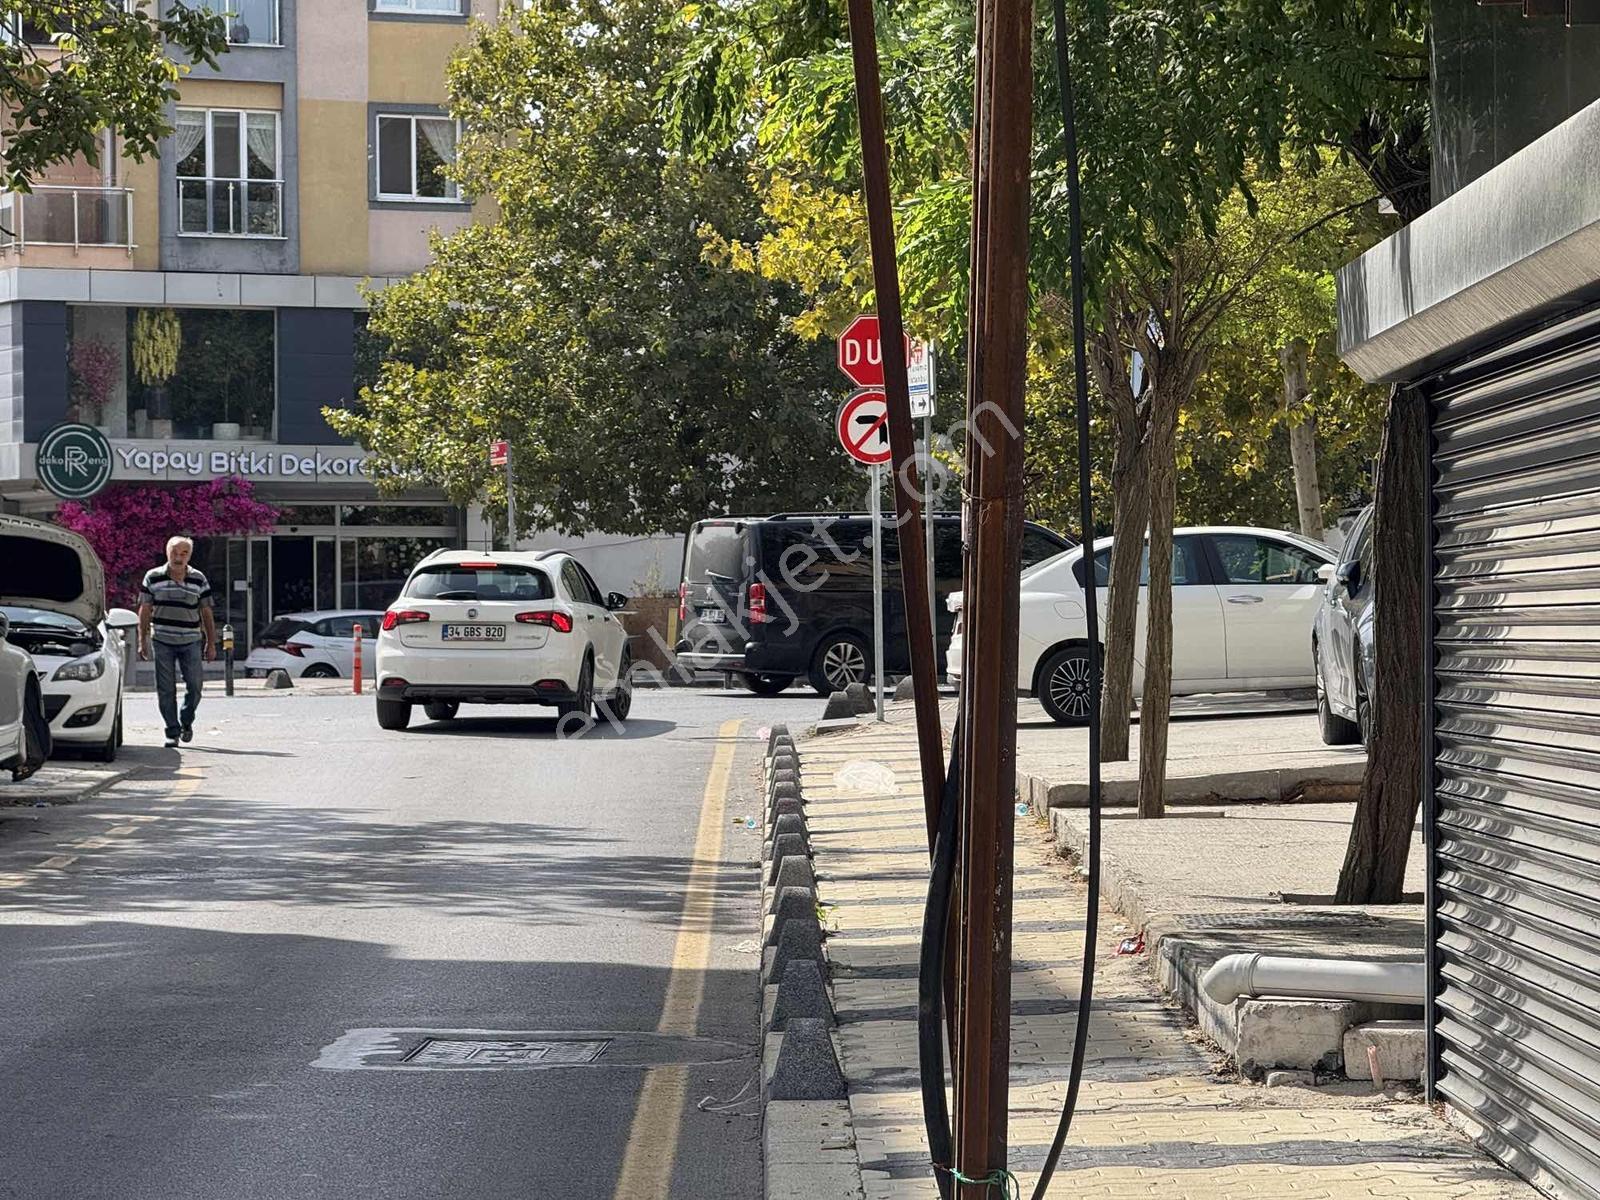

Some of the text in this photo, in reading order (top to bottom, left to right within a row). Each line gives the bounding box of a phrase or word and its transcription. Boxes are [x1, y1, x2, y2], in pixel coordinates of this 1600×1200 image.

[117, 448, 203, 475] Yapay
[210, 451, 273, 474] Bitki
[448, 627, 460, 637] 34
[463, 626, 482, 638] GBS
[485, 627, 503, 638] 820
